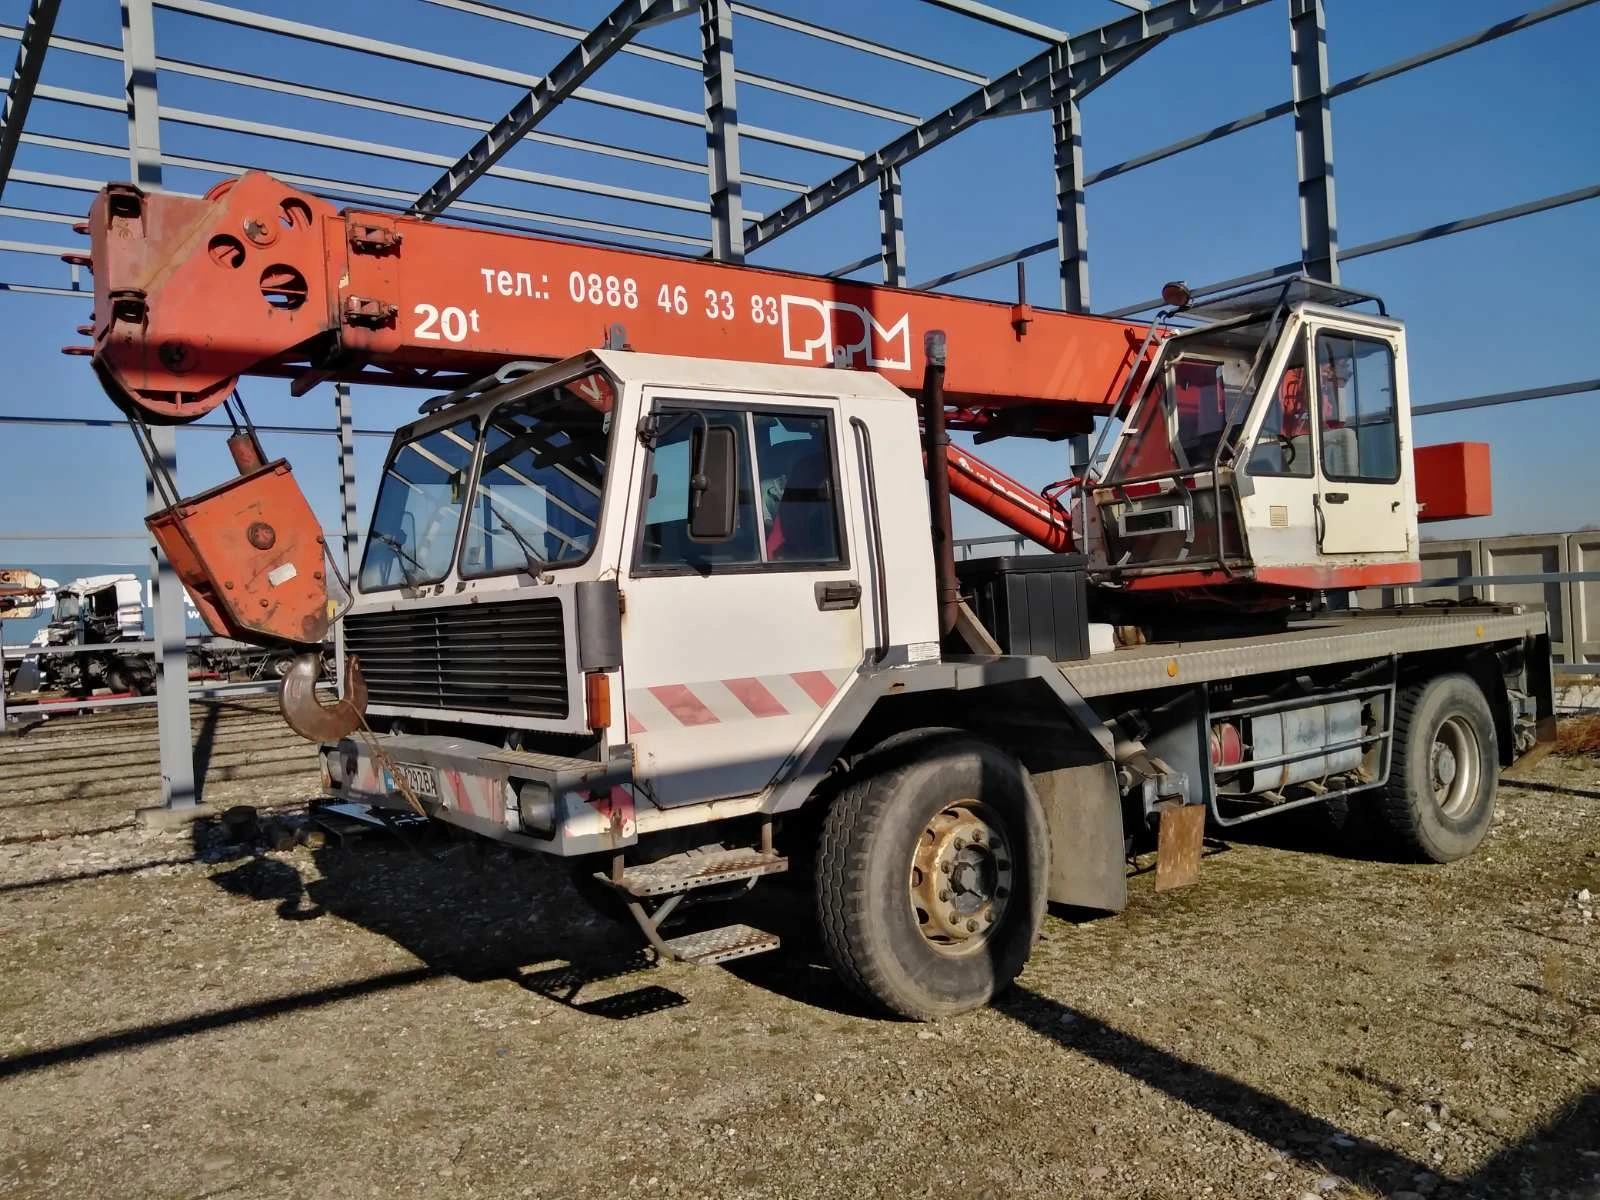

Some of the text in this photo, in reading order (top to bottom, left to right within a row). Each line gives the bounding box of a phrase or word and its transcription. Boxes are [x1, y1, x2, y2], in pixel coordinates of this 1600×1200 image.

[481, 268, 779, 325] тел.: 0888 46 33 83
[781, 294, 911, 370] PPM
